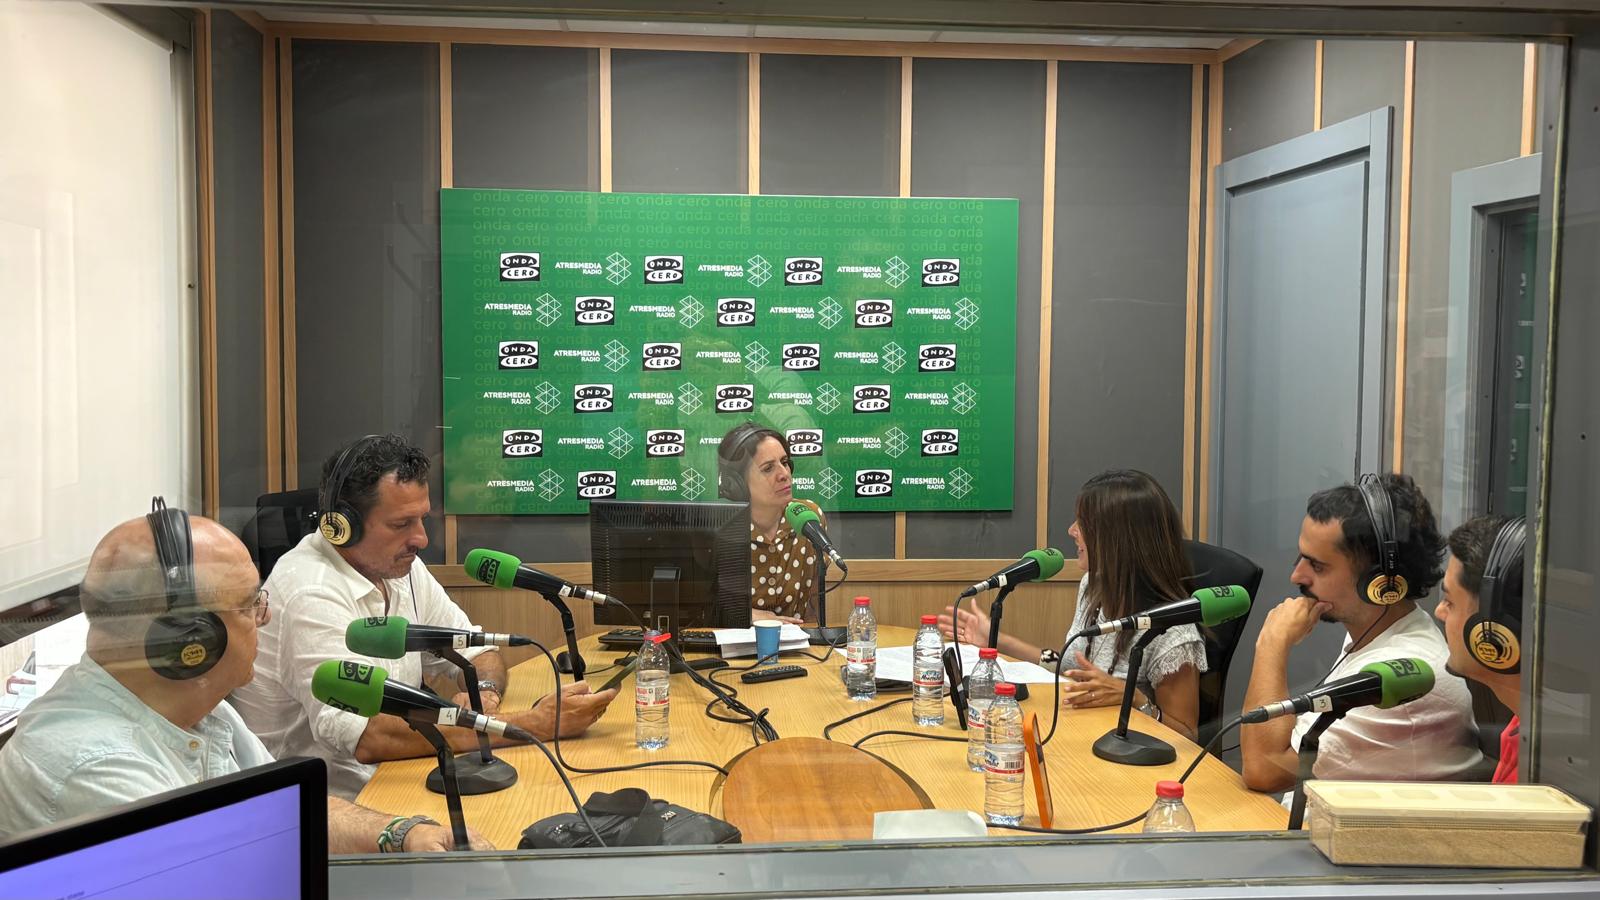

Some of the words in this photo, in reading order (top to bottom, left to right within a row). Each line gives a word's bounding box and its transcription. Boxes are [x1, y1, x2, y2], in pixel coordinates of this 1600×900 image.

[473, 192, 510, 202] onda
[554, 194, 592, 204] onda
[598, 196, 630, 205] cero
[636, 196, 672, 206] onda
[678, 198, 710, 207] cero
[715, 198, 751, 207] onda
[757, 199, 788, 208] cero
[794, 198, 829, 209] onda
[835, 200, 866, 209] cero
[872, 199, 907, 209] onda
[913, 201, 943, 210] cero
[948, 200, 984, 210] onda
[473, 207, 506, 217] cero
[512, 205, 550, 217] onda
[557, 209, 587, 218] cero
[594, 208, 632, 219] onda
[638, 211, 669, 220] cero
[675, 210, 712, 220] onda
[718, 213, 750, 221] cero
[755, 211, 791, 222] onda
[797, 214, 828, 223] cero
[834, 212, 869, 223] onda
[875, 215, 905, 224] cero
[912, 213, 947, 224] onda
[953, 215, 983, 224] cero
[473, 219, 510, 231] onda
[516, 223, 550, 232] cero
[555, 221, 592, 232] onda
[598, 224, 630, 233] cero
[636, 223, 672, 234] onda
[678, 226, 710, 234] cero
[715, 225, 751, 235] onda
[757, 227, 788, 236] cero
[794, 226, 829, 236] onda
[835, 228, 866, 236] cero
[872, 226, 907, 237] onda
[912, 229, 943, 237] cero
[948, 227, 983, 238] onda
[473, 236, 506, 245] cero
[512, 234, 550, 246] onda
[557, 238, 588, 247] cero
[594, 236, 632, 247] onda
[638, 239, 670, 248] cero
[675, 238, 712, 249] onda
[718, 240, 749, 250] cero
[755, 239, 790, 250] onda
[796, 242, 828, 250] cero
[834, 240, 869, 251] onda
[874, 243, 905, 252] cero
[911, 241, 946, 252] onda
[952, 243, 983, 252] cero
[554, 262, 602, 270] ATRESMEDIA
[698, 264, 744, 272] ATRESMEDIA
[582, 476, 611, 484] ONDA
